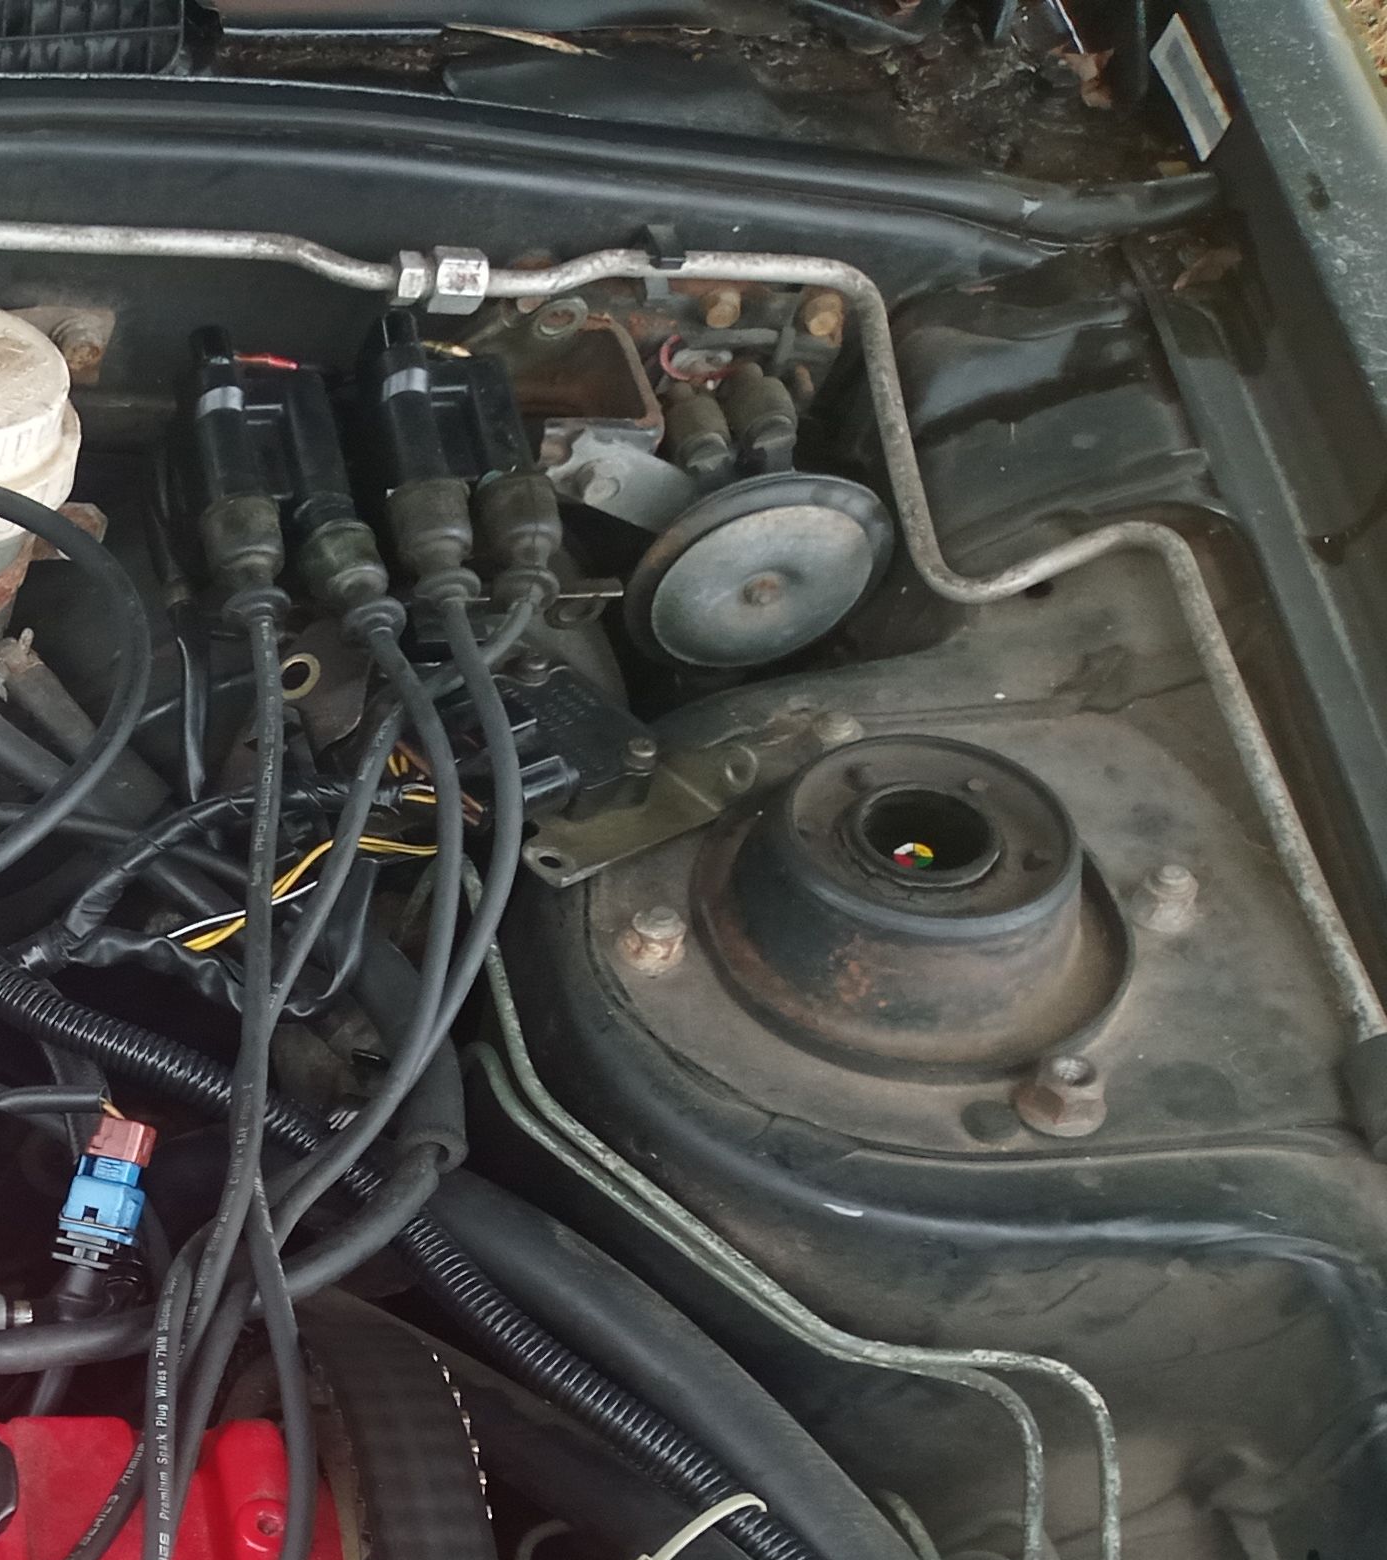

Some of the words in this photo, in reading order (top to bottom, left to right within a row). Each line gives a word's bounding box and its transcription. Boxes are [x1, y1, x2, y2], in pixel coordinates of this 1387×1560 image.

[155, 1335, 169, 1359] 7MM
[155, 1369, 168, 1399] Wires
[155, 1403, 170, 1428] Plug
[155, 1433, 169, 1465] Spark
[158, 1471, 171, 1521] Premium
